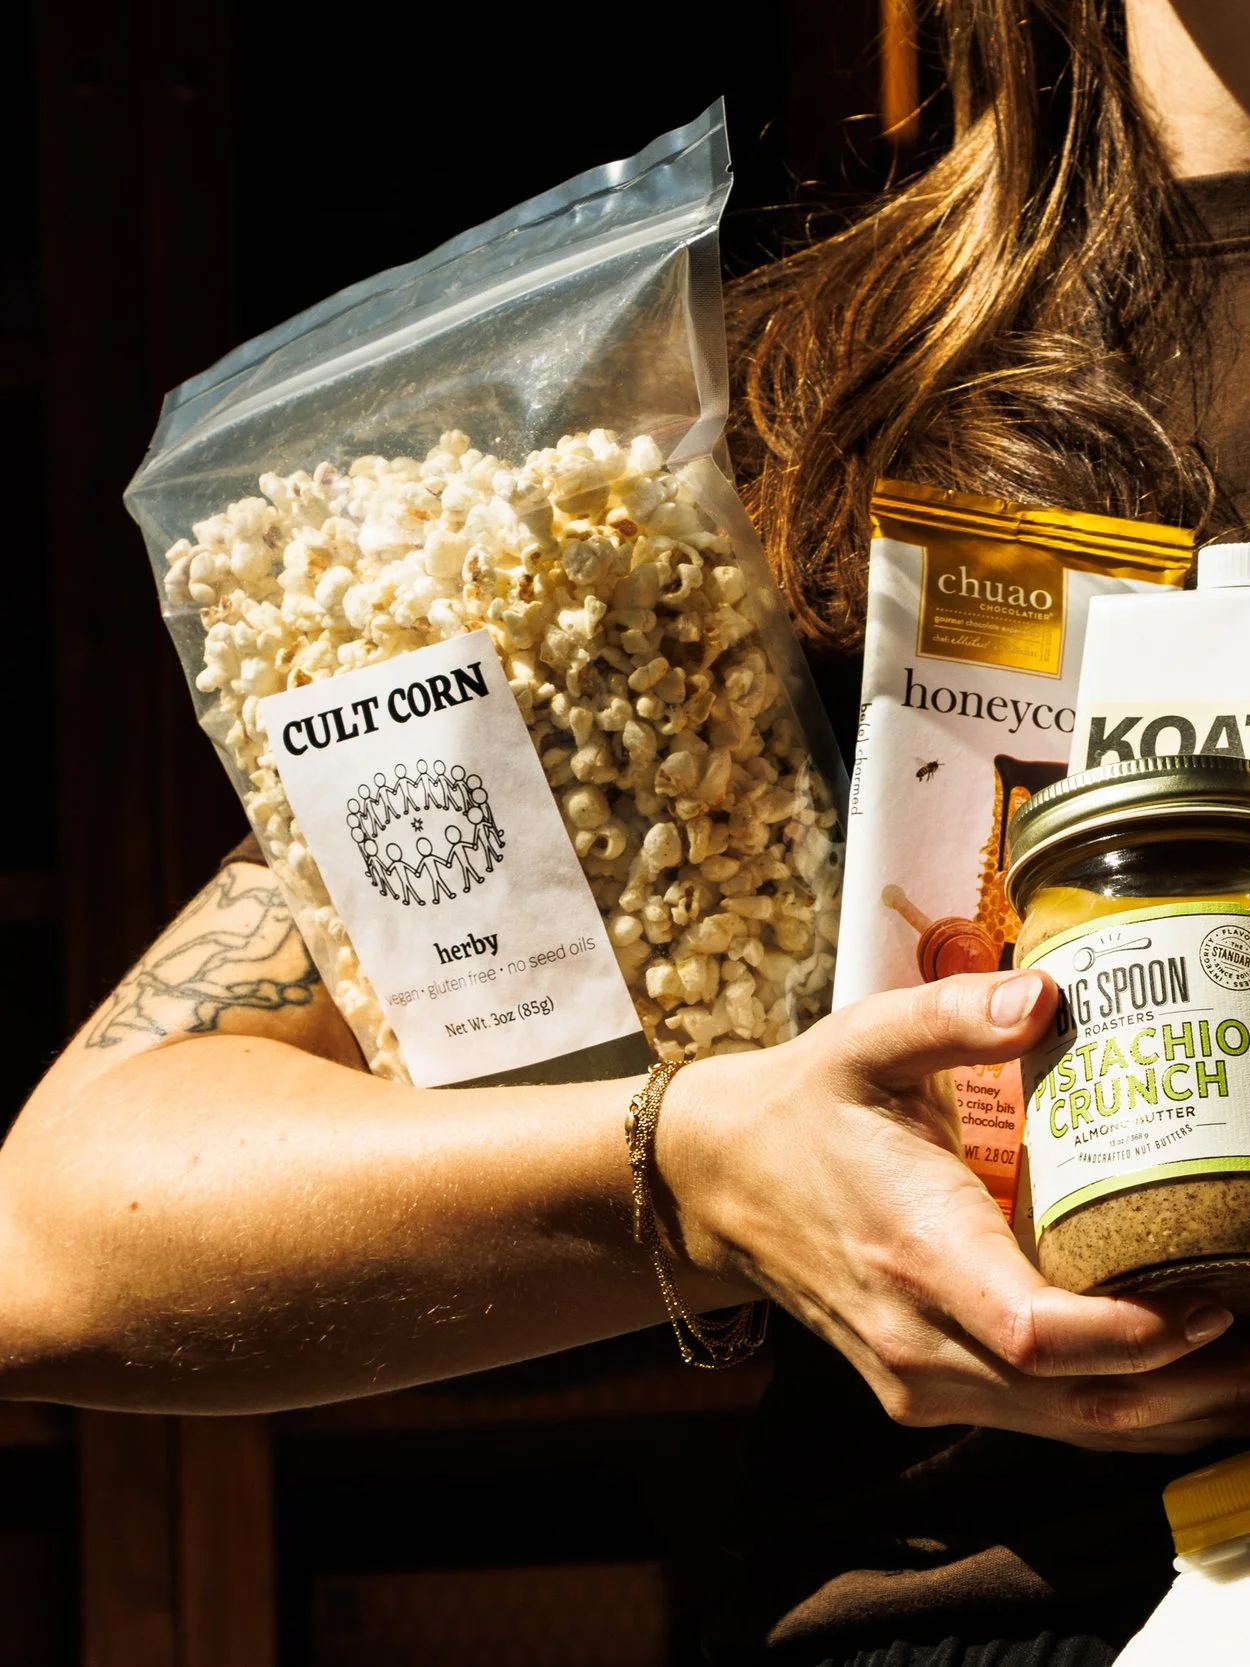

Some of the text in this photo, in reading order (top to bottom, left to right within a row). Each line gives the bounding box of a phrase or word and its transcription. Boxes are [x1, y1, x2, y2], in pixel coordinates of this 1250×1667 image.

[937, 566, 1053, 610] chuao
[979, 603, 1050, 621] CHOCOLATIER
[282, 662, 490, 756] CULT CORN
[433, 932, 499, 965] herby
[1231, 941, 1244, 950] THE
[385, 935, 597, 1007] vegan gluten free no seed oils
[1215, 963, 1233, 979] SINCE
[1057, 956, 1190, 1037] BIG SPOON
[445, 996, 555, 1038] Net Wt. 3oz (85g)
[1085, 1011, 1155, 1038] ROASTERS
[1034, 1018, 1250, 1111] PISTACHIO
[966, 1081, 1000, 1099] honey
[1049, 1060, 1229, 1139] CRUNCH
[962, 1112, 1016, 1131] chocolate
[966, 1100, 993, 1114] crisp
[996, 1101, 1016, 1114] bits
[985, 1147, 999, 1164] 2.8
[1001, 1150, 1016, 1165] OZ
[1135, 1143, 1151, 1156] NUT
[1155, 1123, 1193, 1150] BUTTERS
